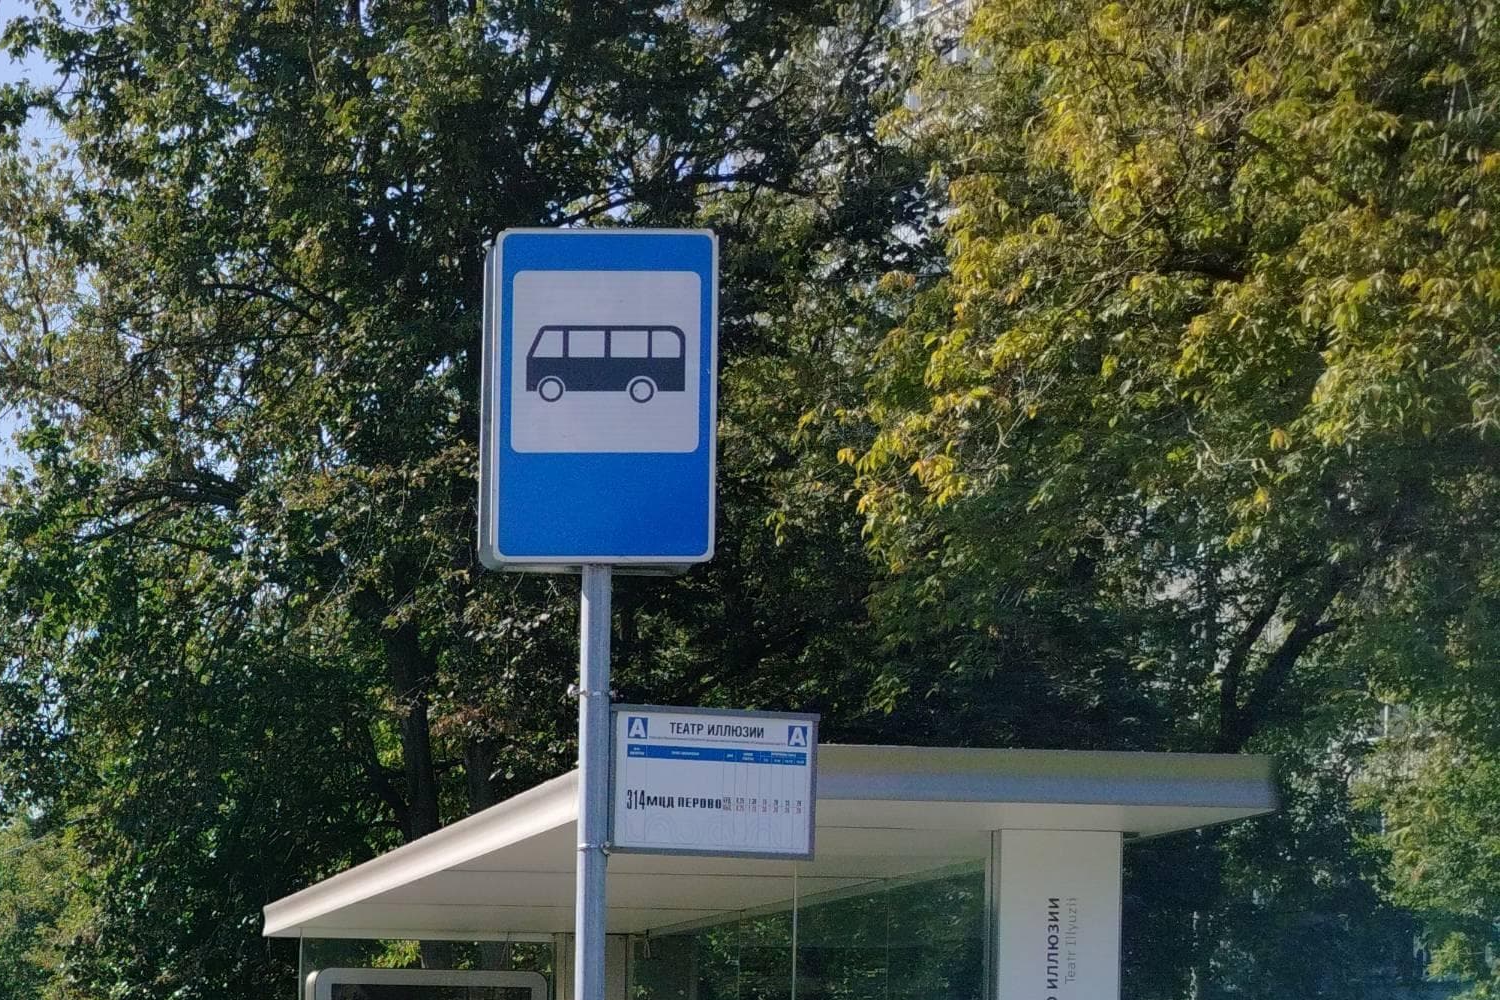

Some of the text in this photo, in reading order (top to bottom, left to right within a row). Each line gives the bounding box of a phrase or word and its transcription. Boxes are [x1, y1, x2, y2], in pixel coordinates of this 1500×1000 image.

[669, 722, 764, 739] ТЕАТР ИЛЛЮЗИИ
[627, 790, 645, 810] 314
[646, 796, 674, 808] МЦД
[677, 796, 722, 809] ПЕРОВО
[1047, 898, 1061, 989] иллюзии
[1065, 897, 1078, 984] Teatr Illyuzii
